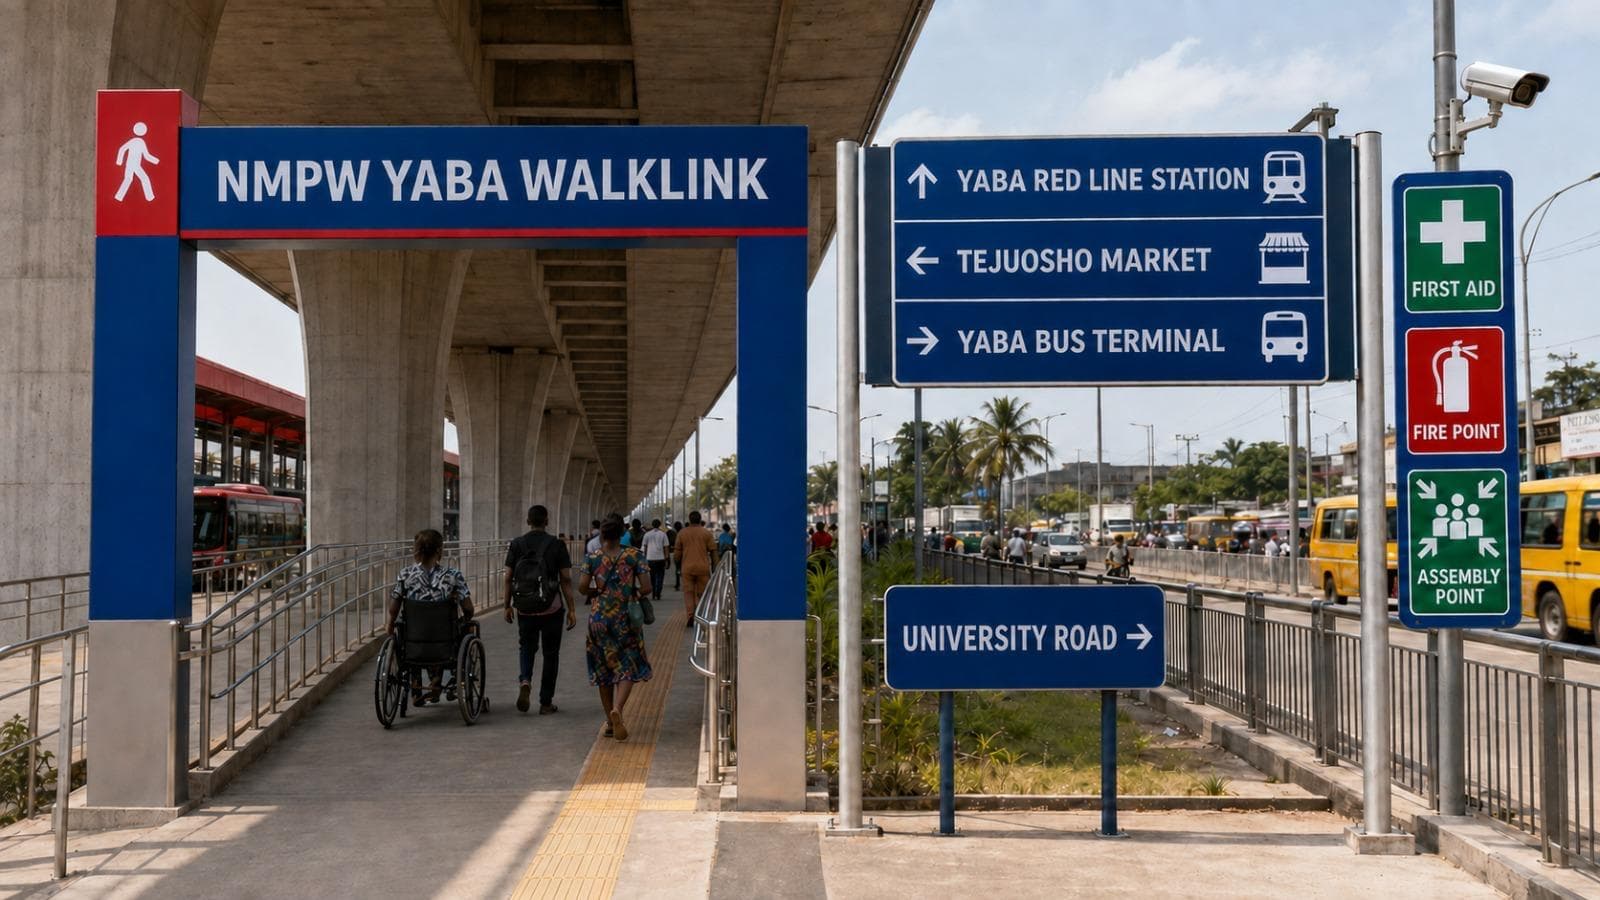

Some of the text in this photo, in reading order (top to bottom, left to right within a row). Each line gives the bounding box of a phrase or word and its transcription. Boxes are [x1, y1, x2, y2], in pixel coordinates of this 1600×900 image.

[218, 158, 769, 202] NMPW YABA WALKLINK
[957, 167, 1249, 193] YABA RED LINE STATION
[956, 247, 1212, 274] TEJUOSHO MARKET
[1412, 280, 1496, 298] FIRST AID
[957, 328, 1225, 354] YABA BUS TERMINAL
[1413, 423, 1500, 440] FIRE POINT
[1417, 568, 1501, 585] ASSEMBLY
[1436, 588, 1485, 605] POINT
[903, 624, 1117, 652] UNIVERSITY ROAD
